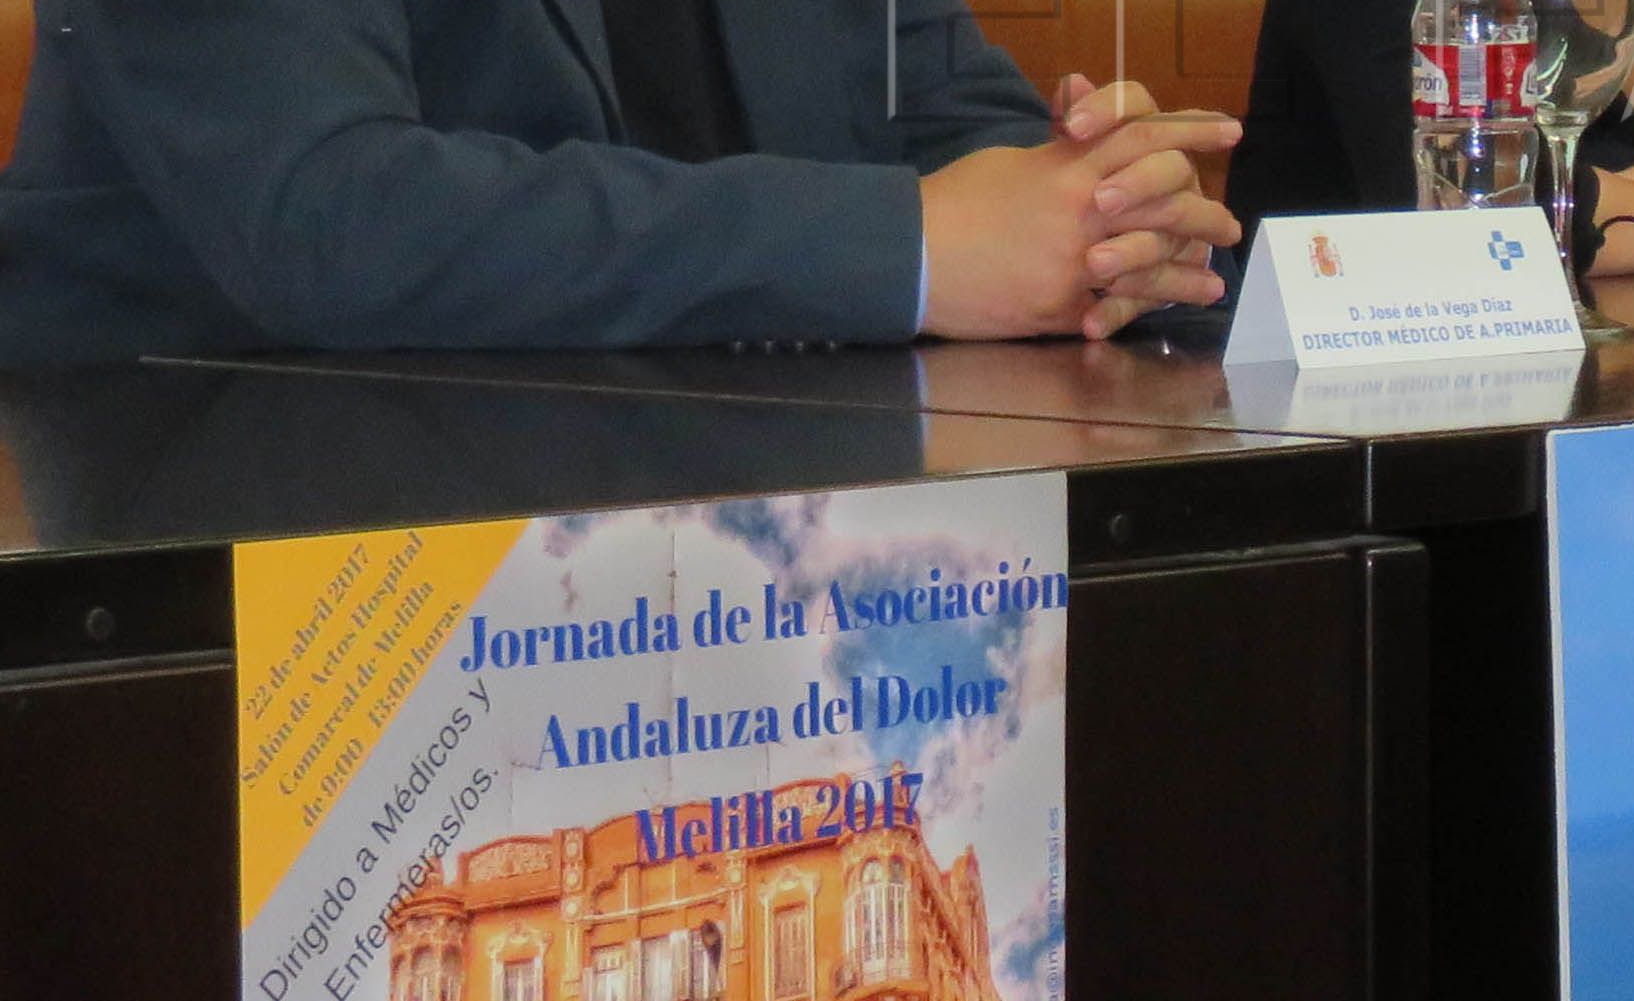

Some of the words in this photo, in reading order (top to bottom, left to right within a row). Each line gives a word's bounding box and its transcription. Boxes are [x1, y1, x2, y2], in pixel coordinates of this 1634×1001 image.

[1302, 330, 1383, 351] DIRECTOR
[1388, 324, 1451, 345] MÉDICO
[1454, 324, 1476, 341] DE
[1349, 305, 1367, 322] D.
[1369, 302, 1402, 321] José
[1405, 302, 1425, 319] de
[1425, 300, 1440, 318] la
[1441, 299, 1479, 319] Vega
[241, 722, 293, 787] Salón
[289, 692, 311, 723] de
[351, 531, 423, 629] Hospital
[246, 685, 273, 720] 22
[269, 659, 291, 690] de
[291, 597, 334, 661] abril
[327, 543, 369, 604] 2017
[356, 657, 377, 688] de
[374, 582, 434, 653] Melilla
[459, 595, 681, 673] Jornada
[693, 588, 752, 647] de
[763, 584, 806, 639] la
[819, 556, 1069, 636] Asociación
[302, 796, 323, 828] de
[410, 603, 461, 666] horas
[538, 696, 780, 771] Andaluza
[792, 676, 863, 740] del
[876, 665, 1008, 731] Dolor
[259, 876, 357, 1001] Dirigido
[355, 846, 380, 875] a
[371, 707, 472, 844] Médicos
[467, 676, 491, 714] y
[635, 787, 805, 865] Melilla
[815, 771, 924, 839] 2017
[325, 769, 498, 1001] Enfermeras/os.
